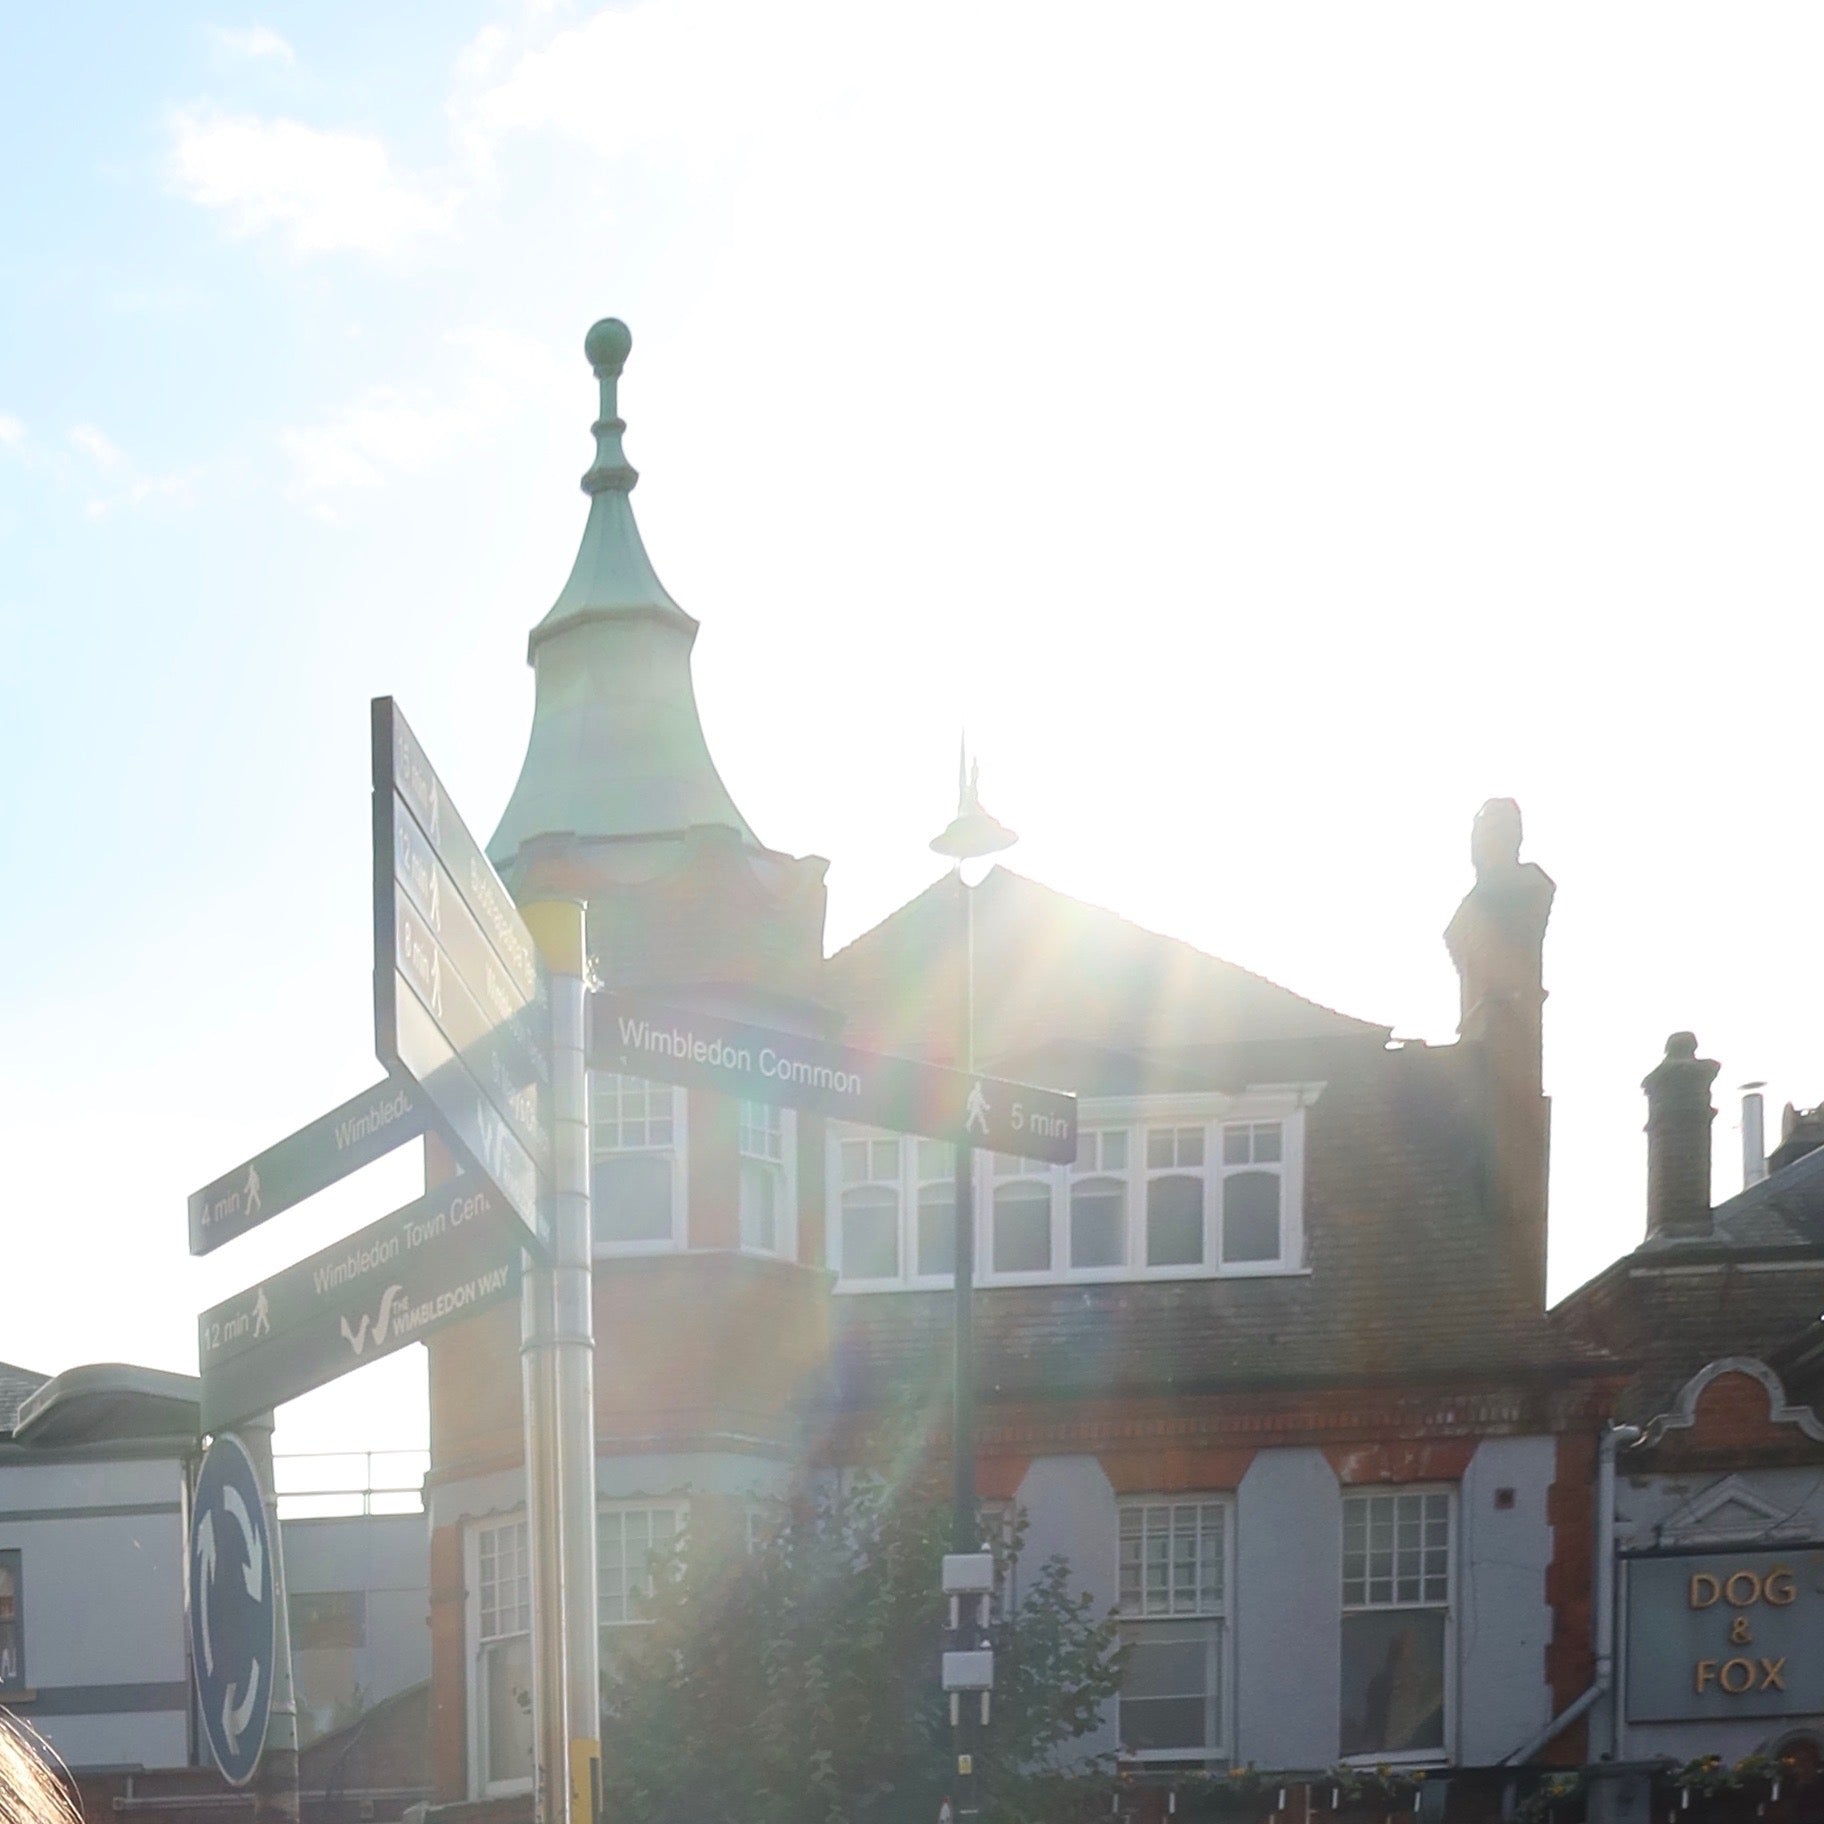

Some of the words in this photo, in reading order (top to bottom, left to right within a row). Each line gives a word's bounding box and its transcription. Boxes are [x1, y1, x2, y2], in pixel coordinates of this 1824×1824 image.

[413, 942, 429, 985] min
[618, 1015, 751, 1072] Wimbledon
[758, 1047, 862, 1096] Common
[1010, 1104, 1024, 1130] 5
[1030, 1108, 1069, 1139] min
[201, 1207, 211, 1227] 4
[213, 1192, 241, 1223] min
[203, 1322, 220, 1351] 12
[223, 1312, 250, 1343] min
[312, 1237, 398, 1295] Wimbledon
[403, 1212, 446, 1250] Town
[449, 1191, 492, 1227] Cen
[392, 1279, 476, 1336] WIMBLEDON
[479, 1264, 510, 1296] WAY
[392, 1296, 409, 1313] THE
[1689, 1569, 1797, 1608] DOG
[1732, 1616, 1753, 1643] &
[1695, 1656, 1787, 1693] FOX
